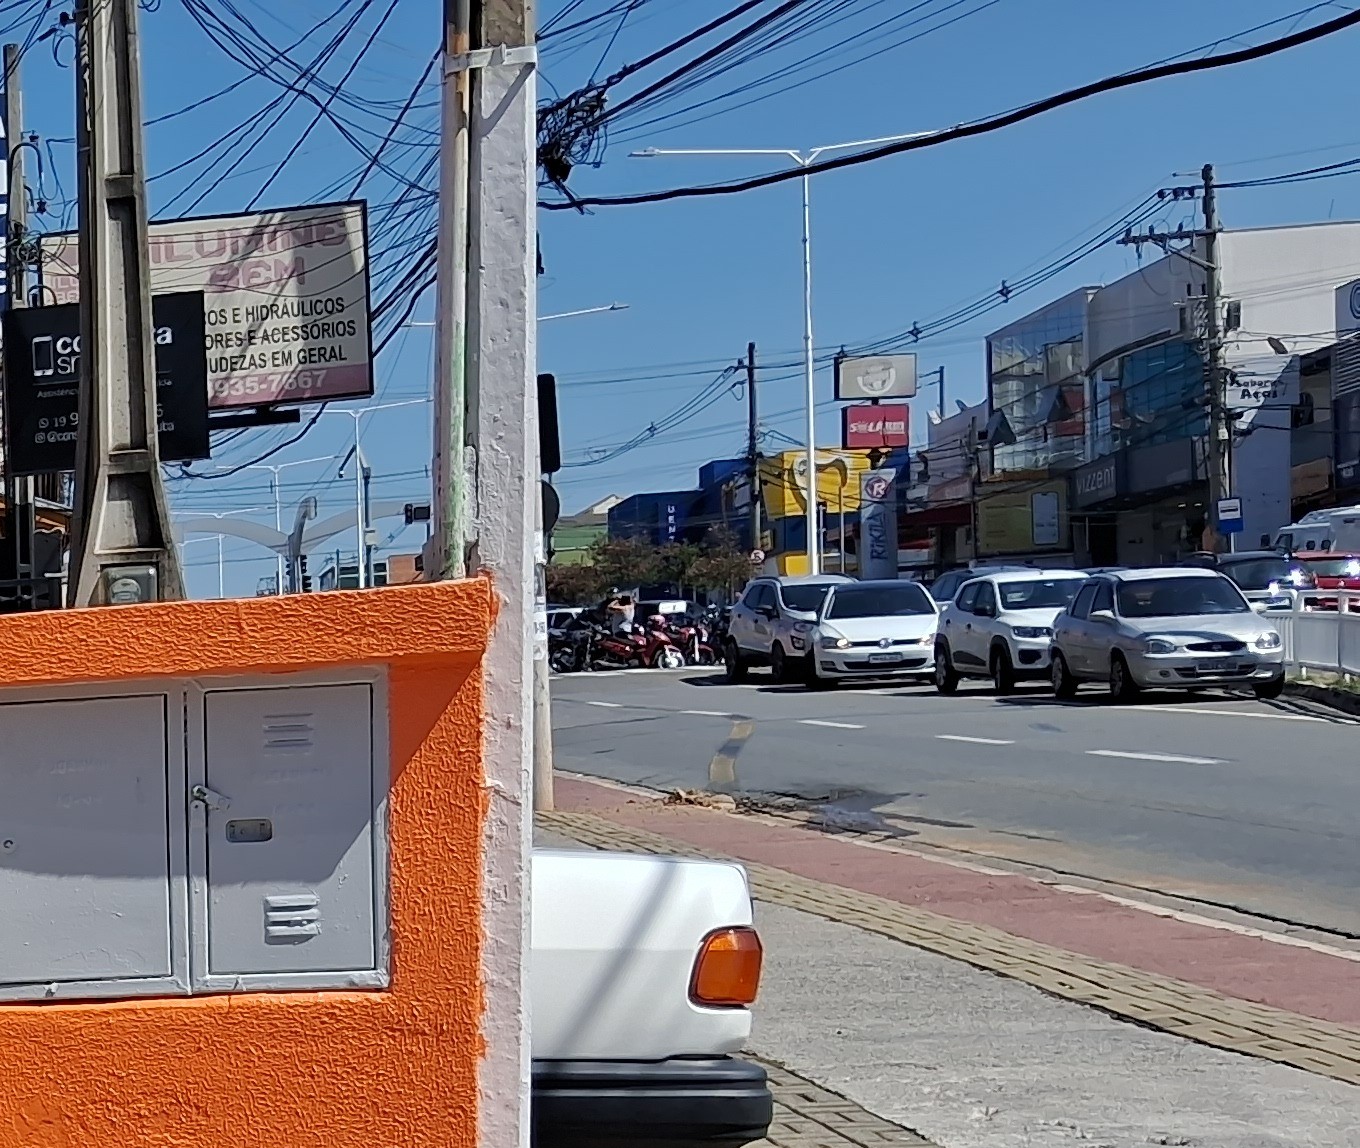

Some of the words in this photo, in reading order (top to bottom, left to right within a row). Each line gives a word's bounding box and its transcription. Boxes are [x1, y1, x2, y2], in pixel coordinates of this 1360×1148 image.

[232, 307, 242, 324] E
[244, 296, 346, 323] HIDRÁULICOS
[247, 330, 257, 347] E
[260, 319, 357, 345] ACESSÓRIOS
[208, 353, 268, 375] UDEZAS
[271, 351, 293, 368] EM
[296, 344, 348, 365] GERAL
